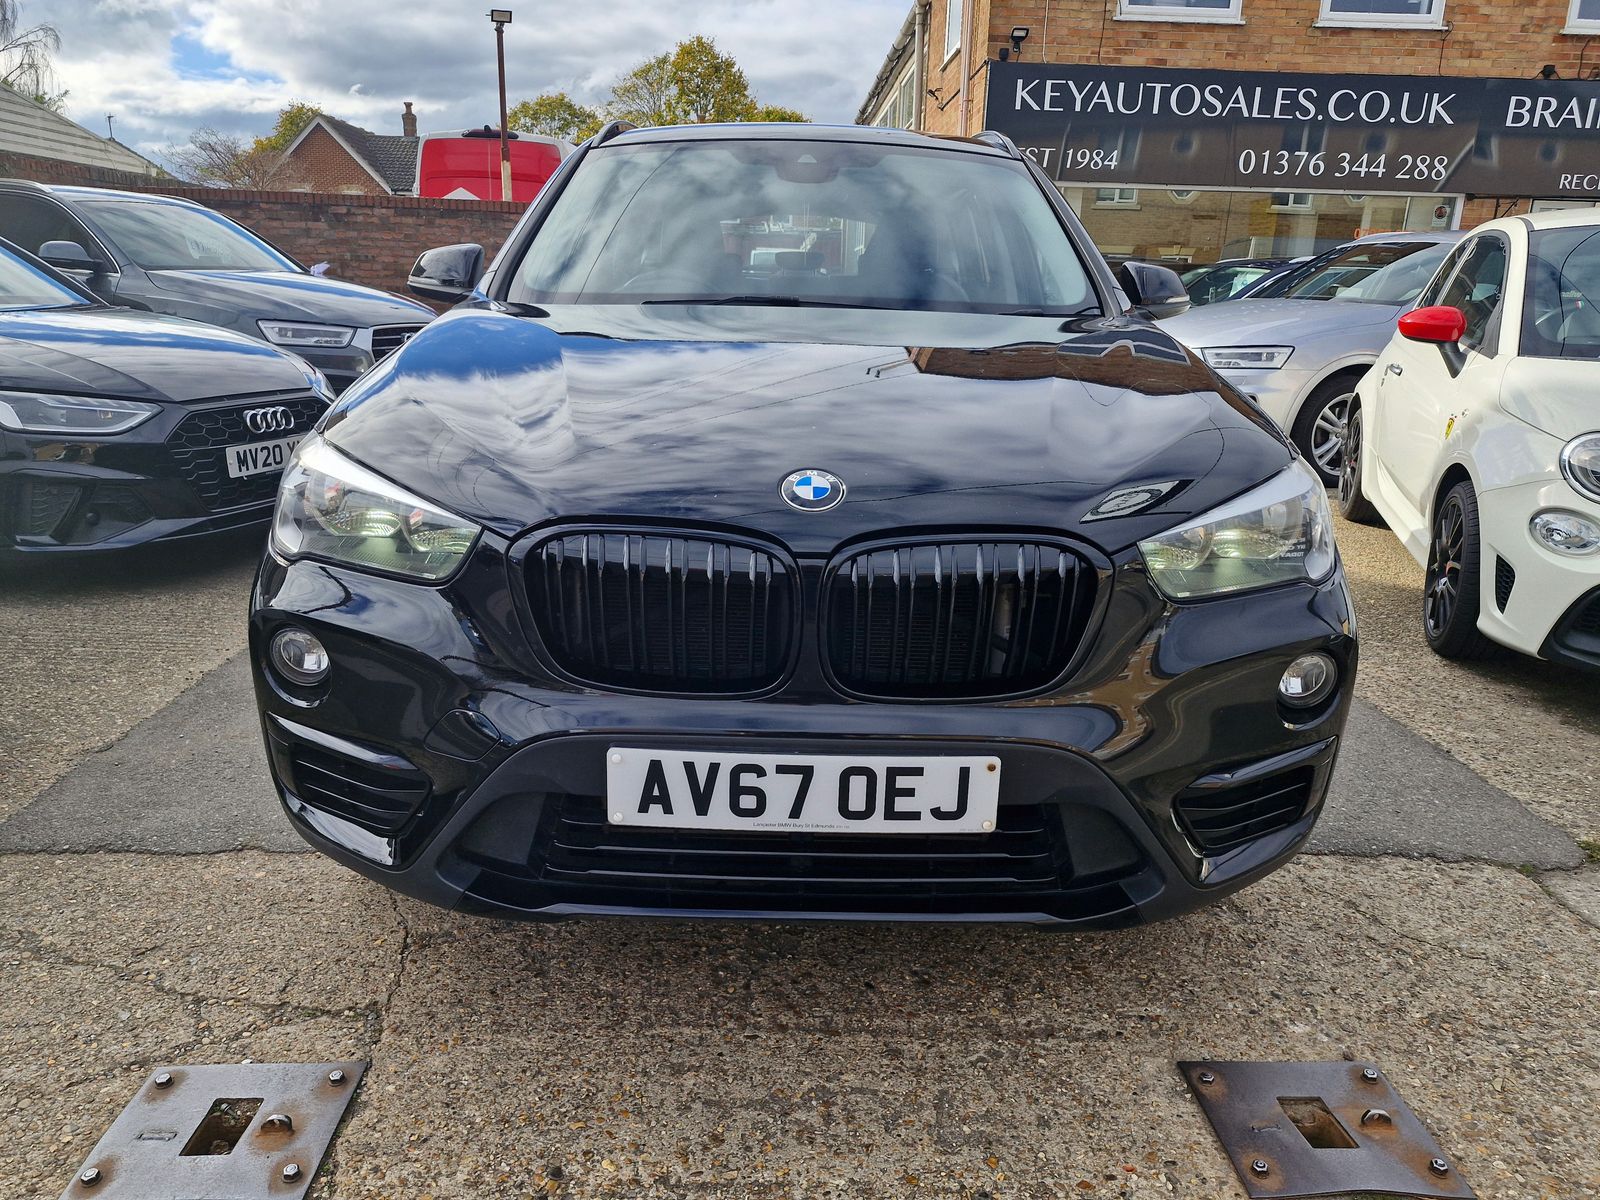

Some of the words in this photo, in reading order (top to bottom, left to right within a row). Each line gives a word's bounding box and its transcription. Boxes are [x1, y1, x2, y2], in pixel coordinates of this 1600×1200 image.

[1014, 78, 1456, 125] KEYAUTOSALES.CO.UK
[1505, 96, 1600, 129] BRAI
[1017, 147, 1056, 168] ST
[1065, 148, 1118, 170] 1984
[1238, 149, 1327, 177] 01376
[1334, 152, 1386, 178] 344
[1395, 154, 1448, 181] 288
[1559, 173, 1600, 190] REC
[236, 444, 283, 472] MV20
[637, 759, 814, 819] AV67
